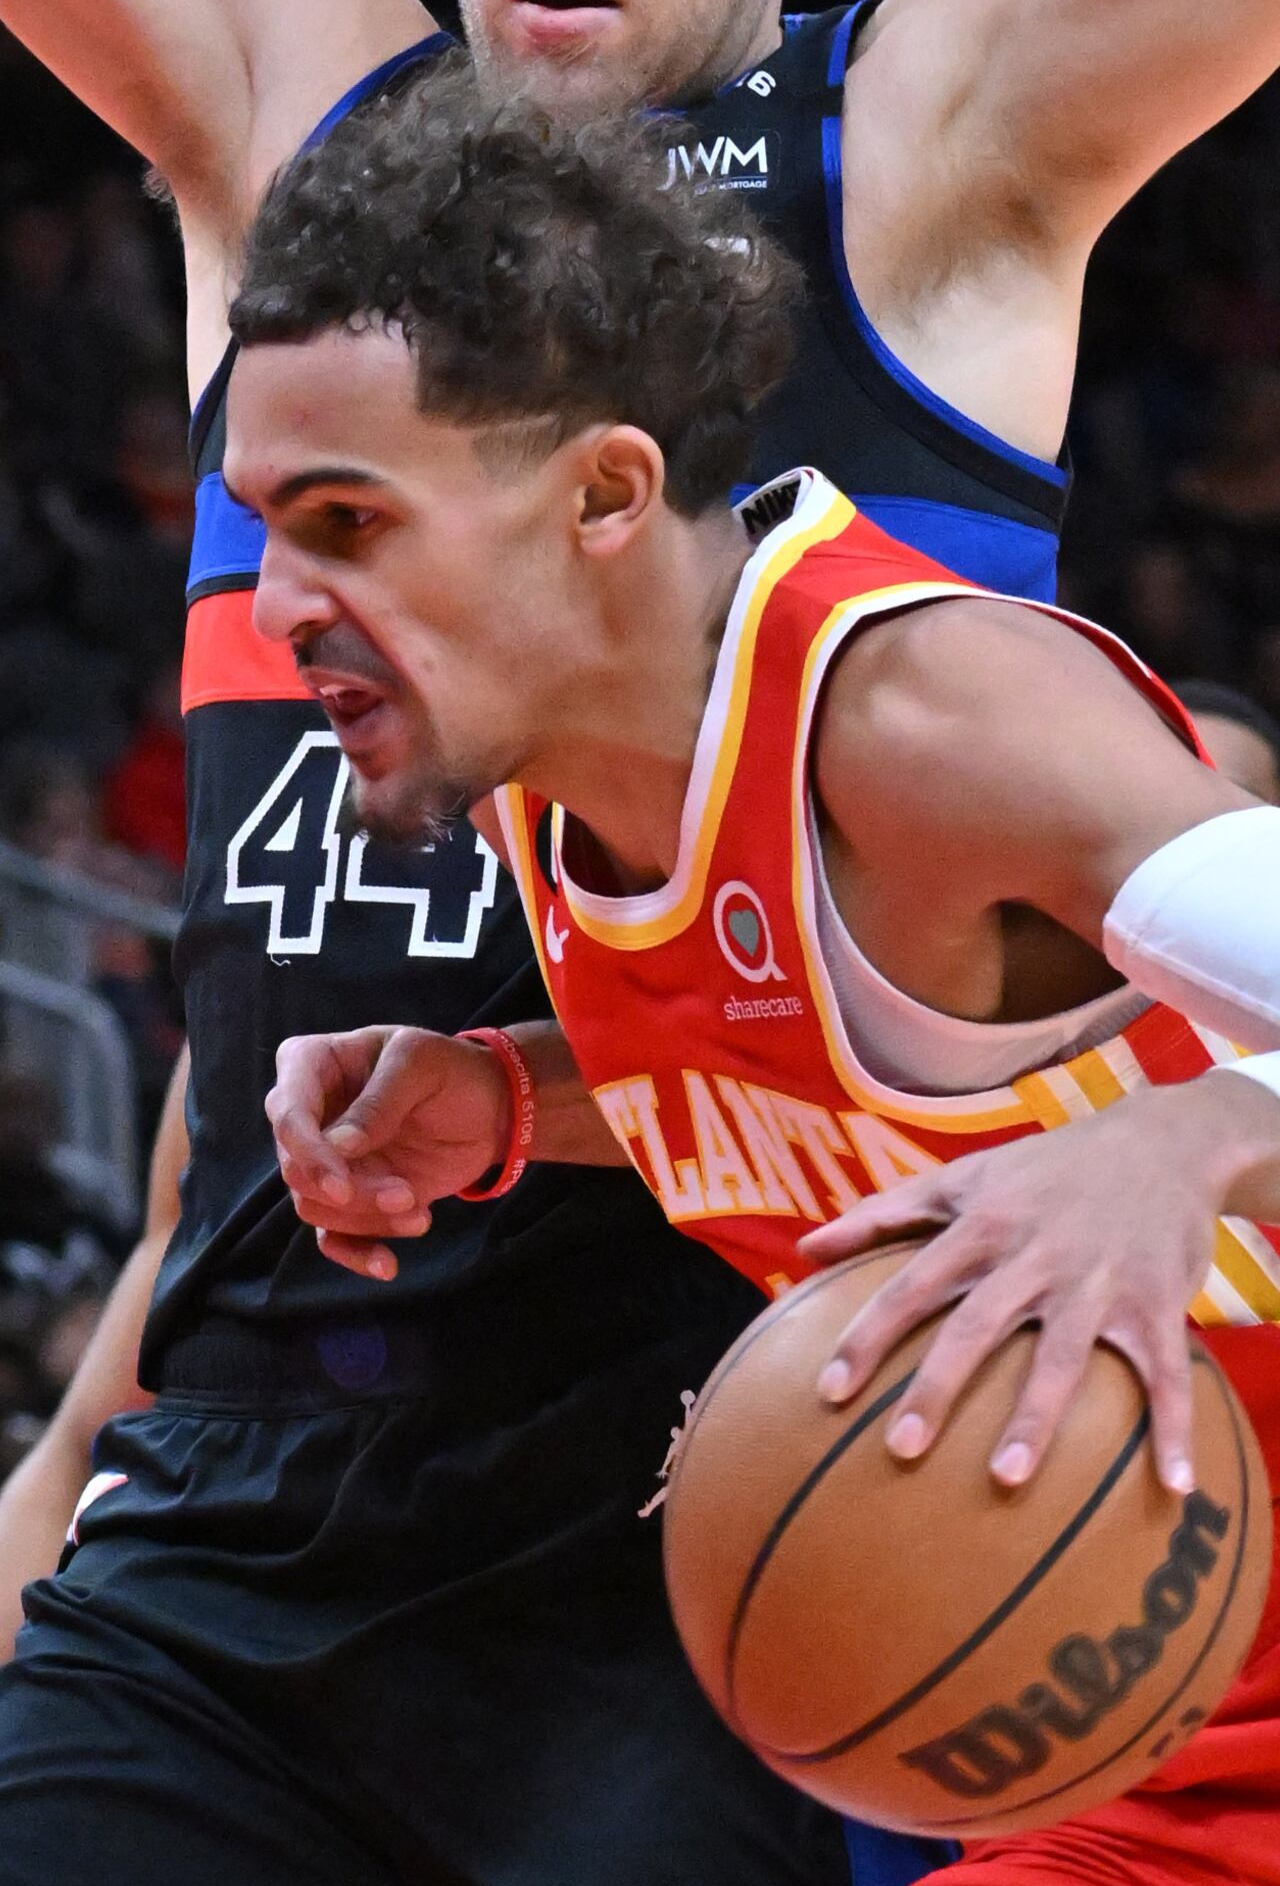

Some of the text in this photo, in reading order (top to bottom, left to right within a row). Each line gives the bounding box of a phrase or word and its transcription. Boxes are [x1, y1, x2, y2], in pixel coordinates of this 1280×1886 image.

[225, 730, 497, 959] 44
[723, 995, 804, 1022] sharecare
[898, 1488, 1232, 1798] Wilson
